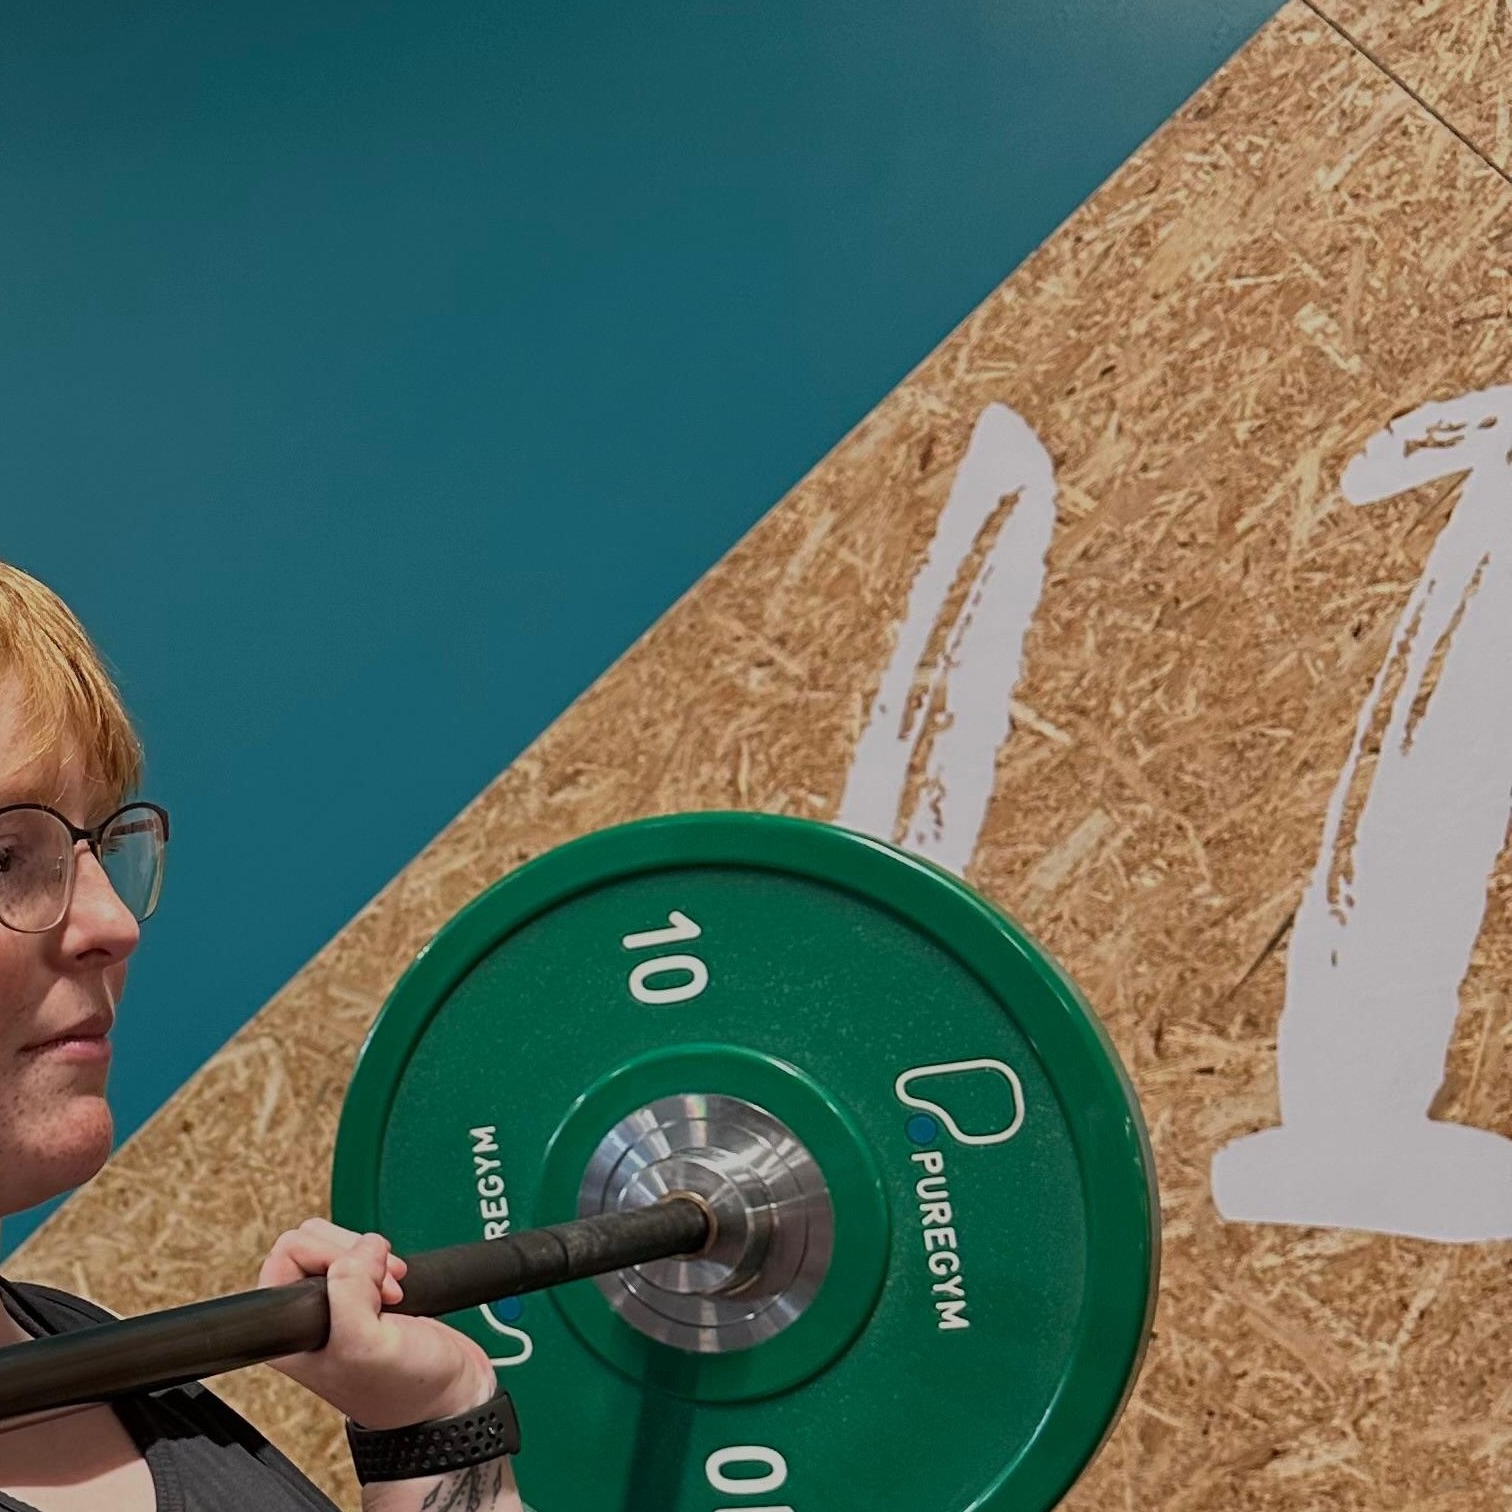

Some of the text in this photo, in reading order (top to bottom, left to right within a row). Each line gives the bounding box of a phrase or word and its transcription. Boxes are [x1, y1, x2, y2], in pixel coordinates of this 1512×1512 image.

[621, 909, 710, 1005] 10
[468, 1124, 513, 1242] REGYM
[910, 1149, 970, 1331] PUREGYM
